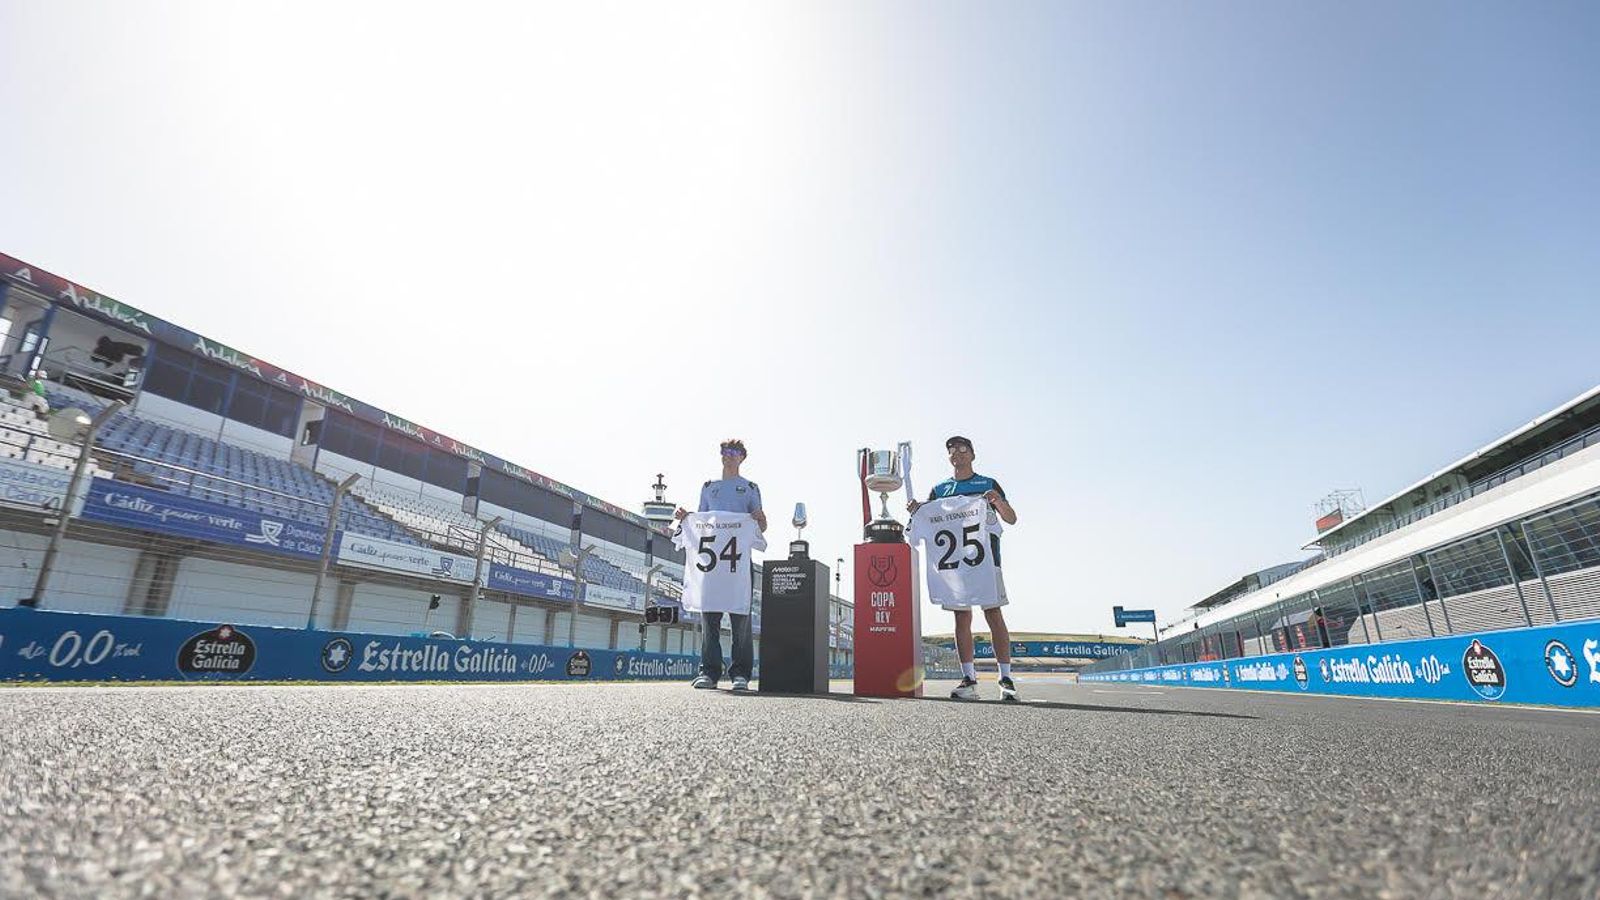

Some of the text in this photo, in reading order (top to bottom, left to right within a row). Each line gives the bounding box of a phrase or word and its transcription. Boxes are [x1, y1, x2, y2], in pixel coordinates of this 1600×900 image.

[104, 492, 156, 513] Cádiz
[208, 515, 243, 530] verte
[696, 535, 742, 573] 54
[934, 523, 985, 570] 25
[871, 592, 895, 607] COPA
[875, 611, 890, 623] REY
[49, 630, 114, 668] 0,0
[194, 640, 246, 655] Estrella
[1054, 644, 1091, 656] Estrella
[192, 654, 240, 669] Galicia
[358, 641, 449, 673] Estrella
[454, 645, 516, 673] Galicia
[1467, 656, 1496, 669] Estrella
[627, 656, 693, 676] Estrella Galicia
[1330, 657, 1370, 683] Estrella
[1367, 654, 1415, 683] Galicia
[1471, 669, 1499, 682] Galicia
